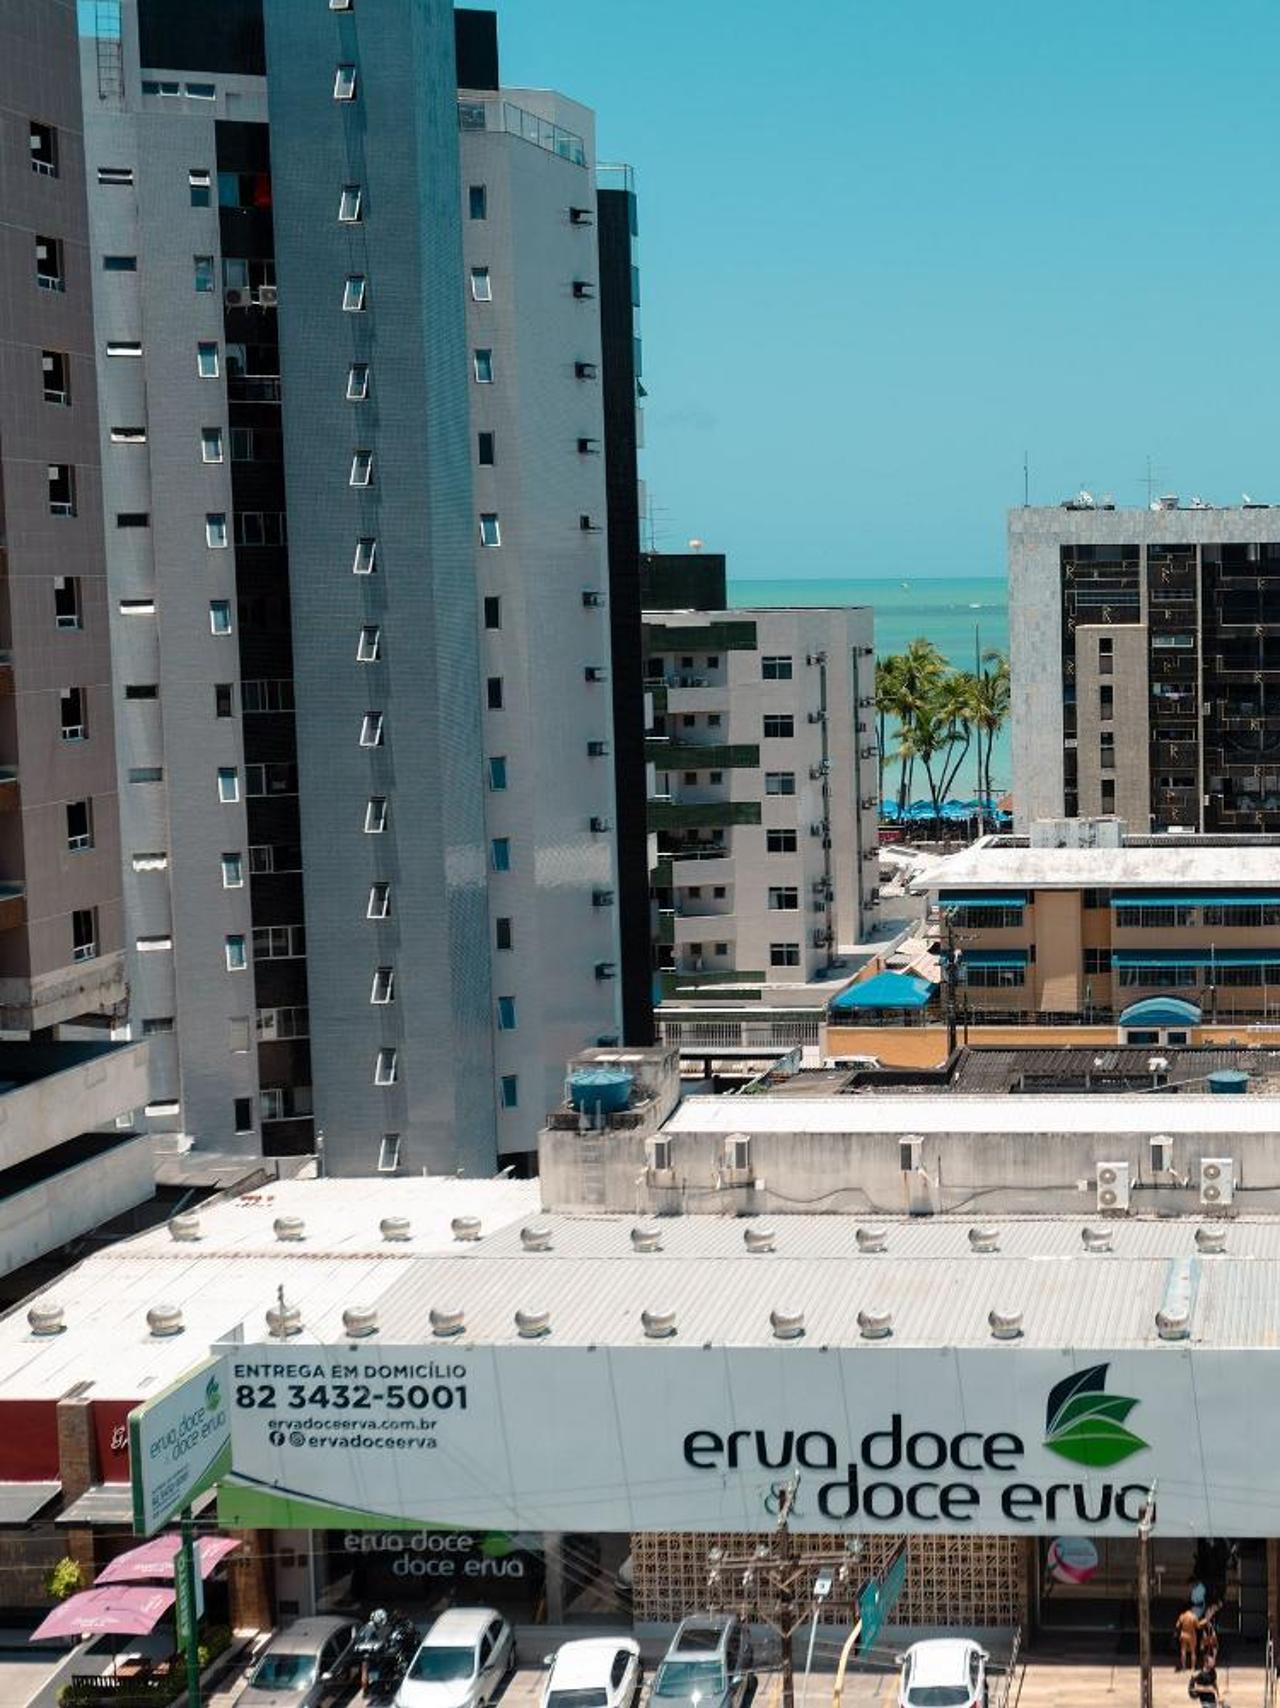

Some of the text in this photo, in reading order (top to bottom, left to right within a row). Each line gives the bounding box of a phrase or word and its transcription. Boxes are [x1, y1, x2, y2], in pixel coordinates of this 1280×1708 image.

[234, 1362, 467, 1379] ENTREGA EM DOMICÍLIO
[236, 1385, 467, 1409] 82 3432-5001
[267, 1417, 437, 1431] ervadoceerva.com.br
[308, 1433, 438, 1449] ervadoceerva
[860, 1413, 1025, 1470] doce
[818, 1464, 980, 1521] doce
[411, 1530, 474, 1551] doce
[393, 1553, 455, 1576] doce
